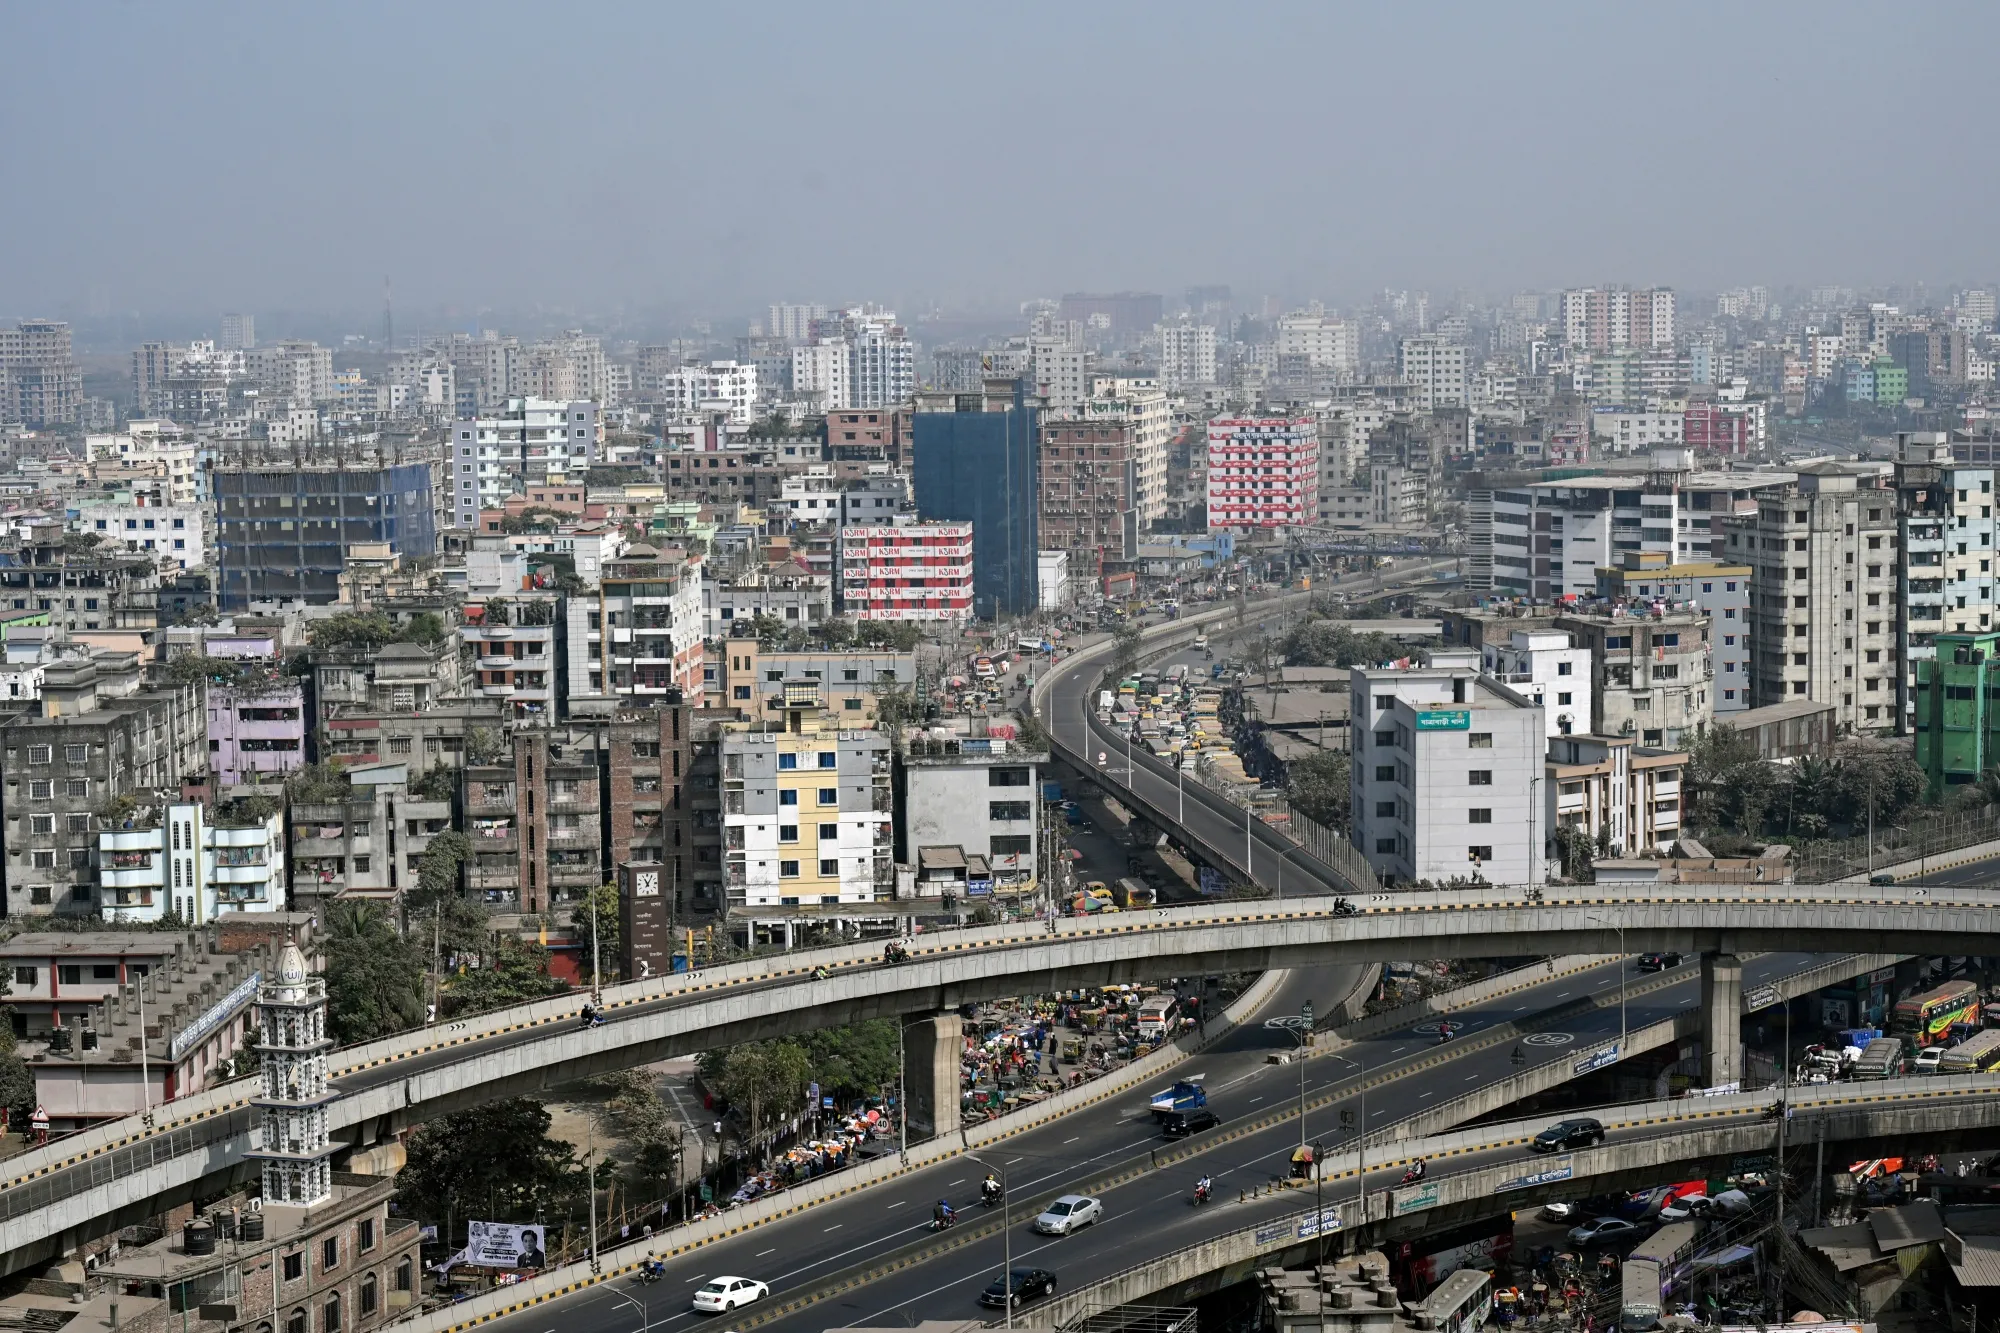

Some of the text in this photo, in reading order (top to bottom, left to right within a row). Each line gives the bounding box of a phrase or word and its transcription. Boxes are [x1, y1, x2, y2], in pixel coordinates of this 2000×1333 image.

[844, 529, 865, 538] KSRM
[878, 528, 899, 536] KSRM
[938, 528, 959, 536] KSRM
[845, 549, 865, 557] KSRM
[879, 547, 900, 555] KSRM
[938, 547, 959, 555] KSRM
[879, 567, 900, 575] KSRM
[938, 568, 959, 576] KSRM
[846, 590, 866, 598] KSRM
[880, 587, 900, 596] KSRM
[880, 610, 900, 618] KSRM
[940, 610, 956, 618] KSR
[1421, 717, 1449, 726] যাত্রাবাড়ী
[878, 1120, 886, 1128] 40
[1526, 1169, 1569, 1183] আই হসপিটাল
